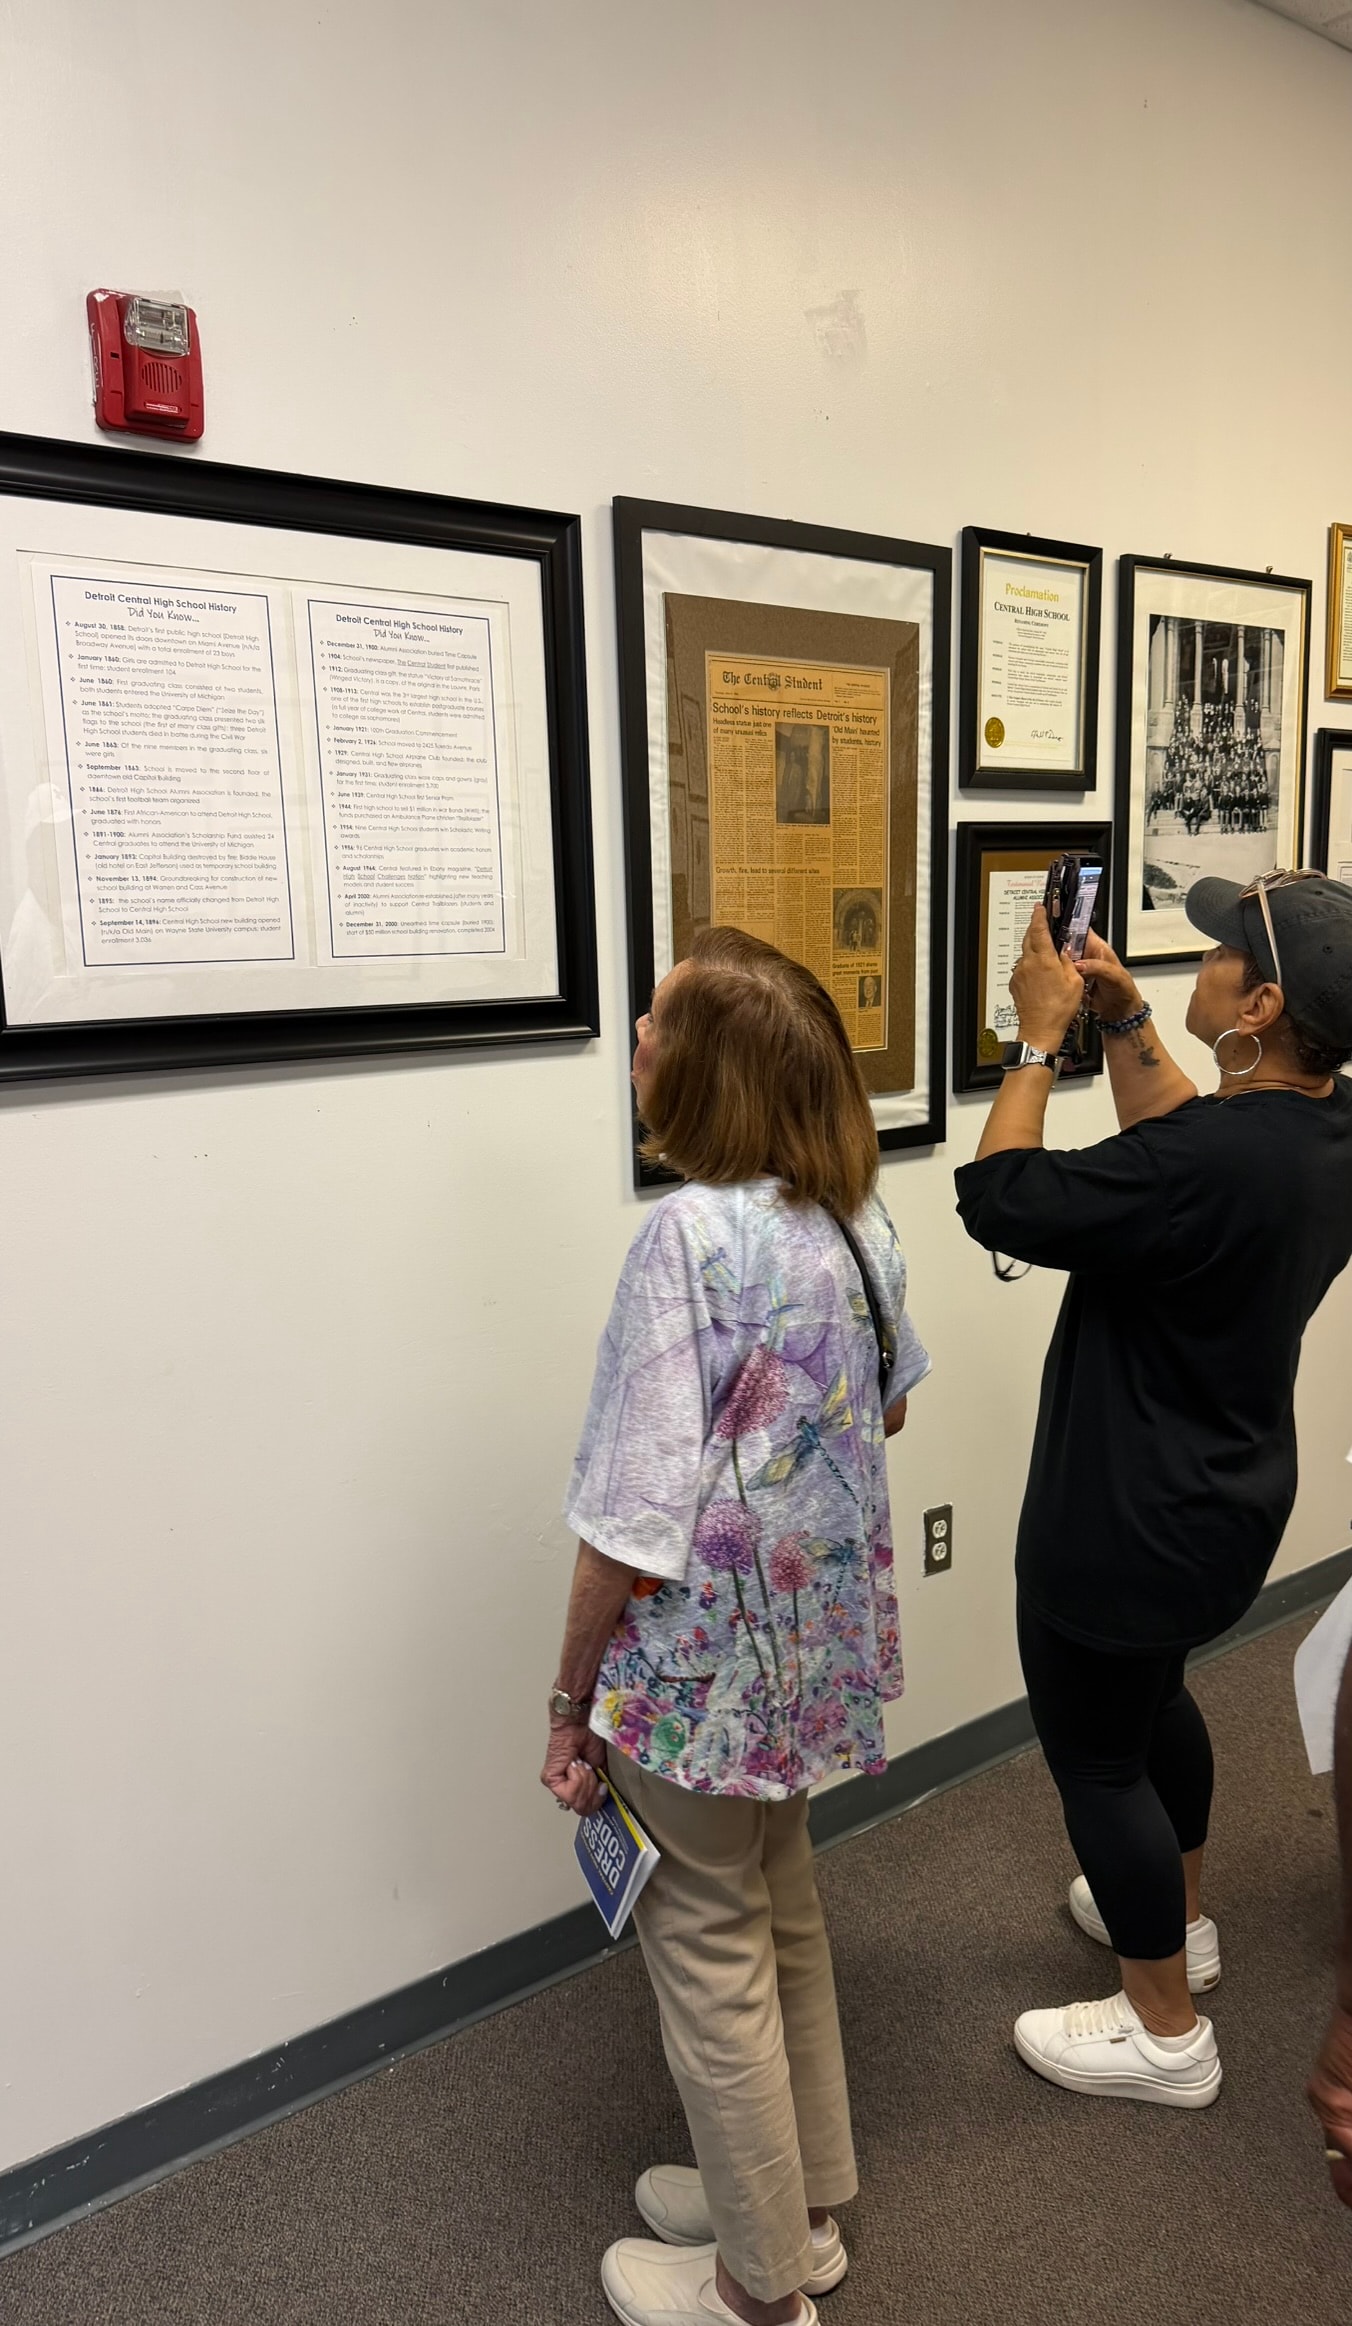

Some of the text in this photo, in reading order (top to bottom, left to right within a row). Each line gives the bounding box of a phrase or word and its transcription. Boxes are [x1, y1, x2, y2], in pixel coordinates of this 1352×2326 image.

[84, 590, 237, 614] Detroit Central High School History
[1006, 583, 1059, 602] Proclamation
[127, 606, 144, 617] Did
[146, 608, 164, 619] You
[994, 602, 1070, 621] CENTRAL HIGH SCHOOL
[74, 621, 96, 630] August
[166, 628, 185, 637] public
[187, 630, 200, 638] high
[335, 614, 463, 635] Detroit Central High School History
[373, 628, 386, 638] Did
[388, 629, 402, 640] You
[77, 653, 103, 662] January
[130, 680, 165, 689] graduating
[723, 671, 740, 685] The
[785, 676, 822, 690] Student
[713, 703, 877, 725] School's history reflects Detroit's history
[333, 724, 354, 732] January
[592, 1810, 626, 1872] CODE
[582, 1816, 620, 1889] DRESS
